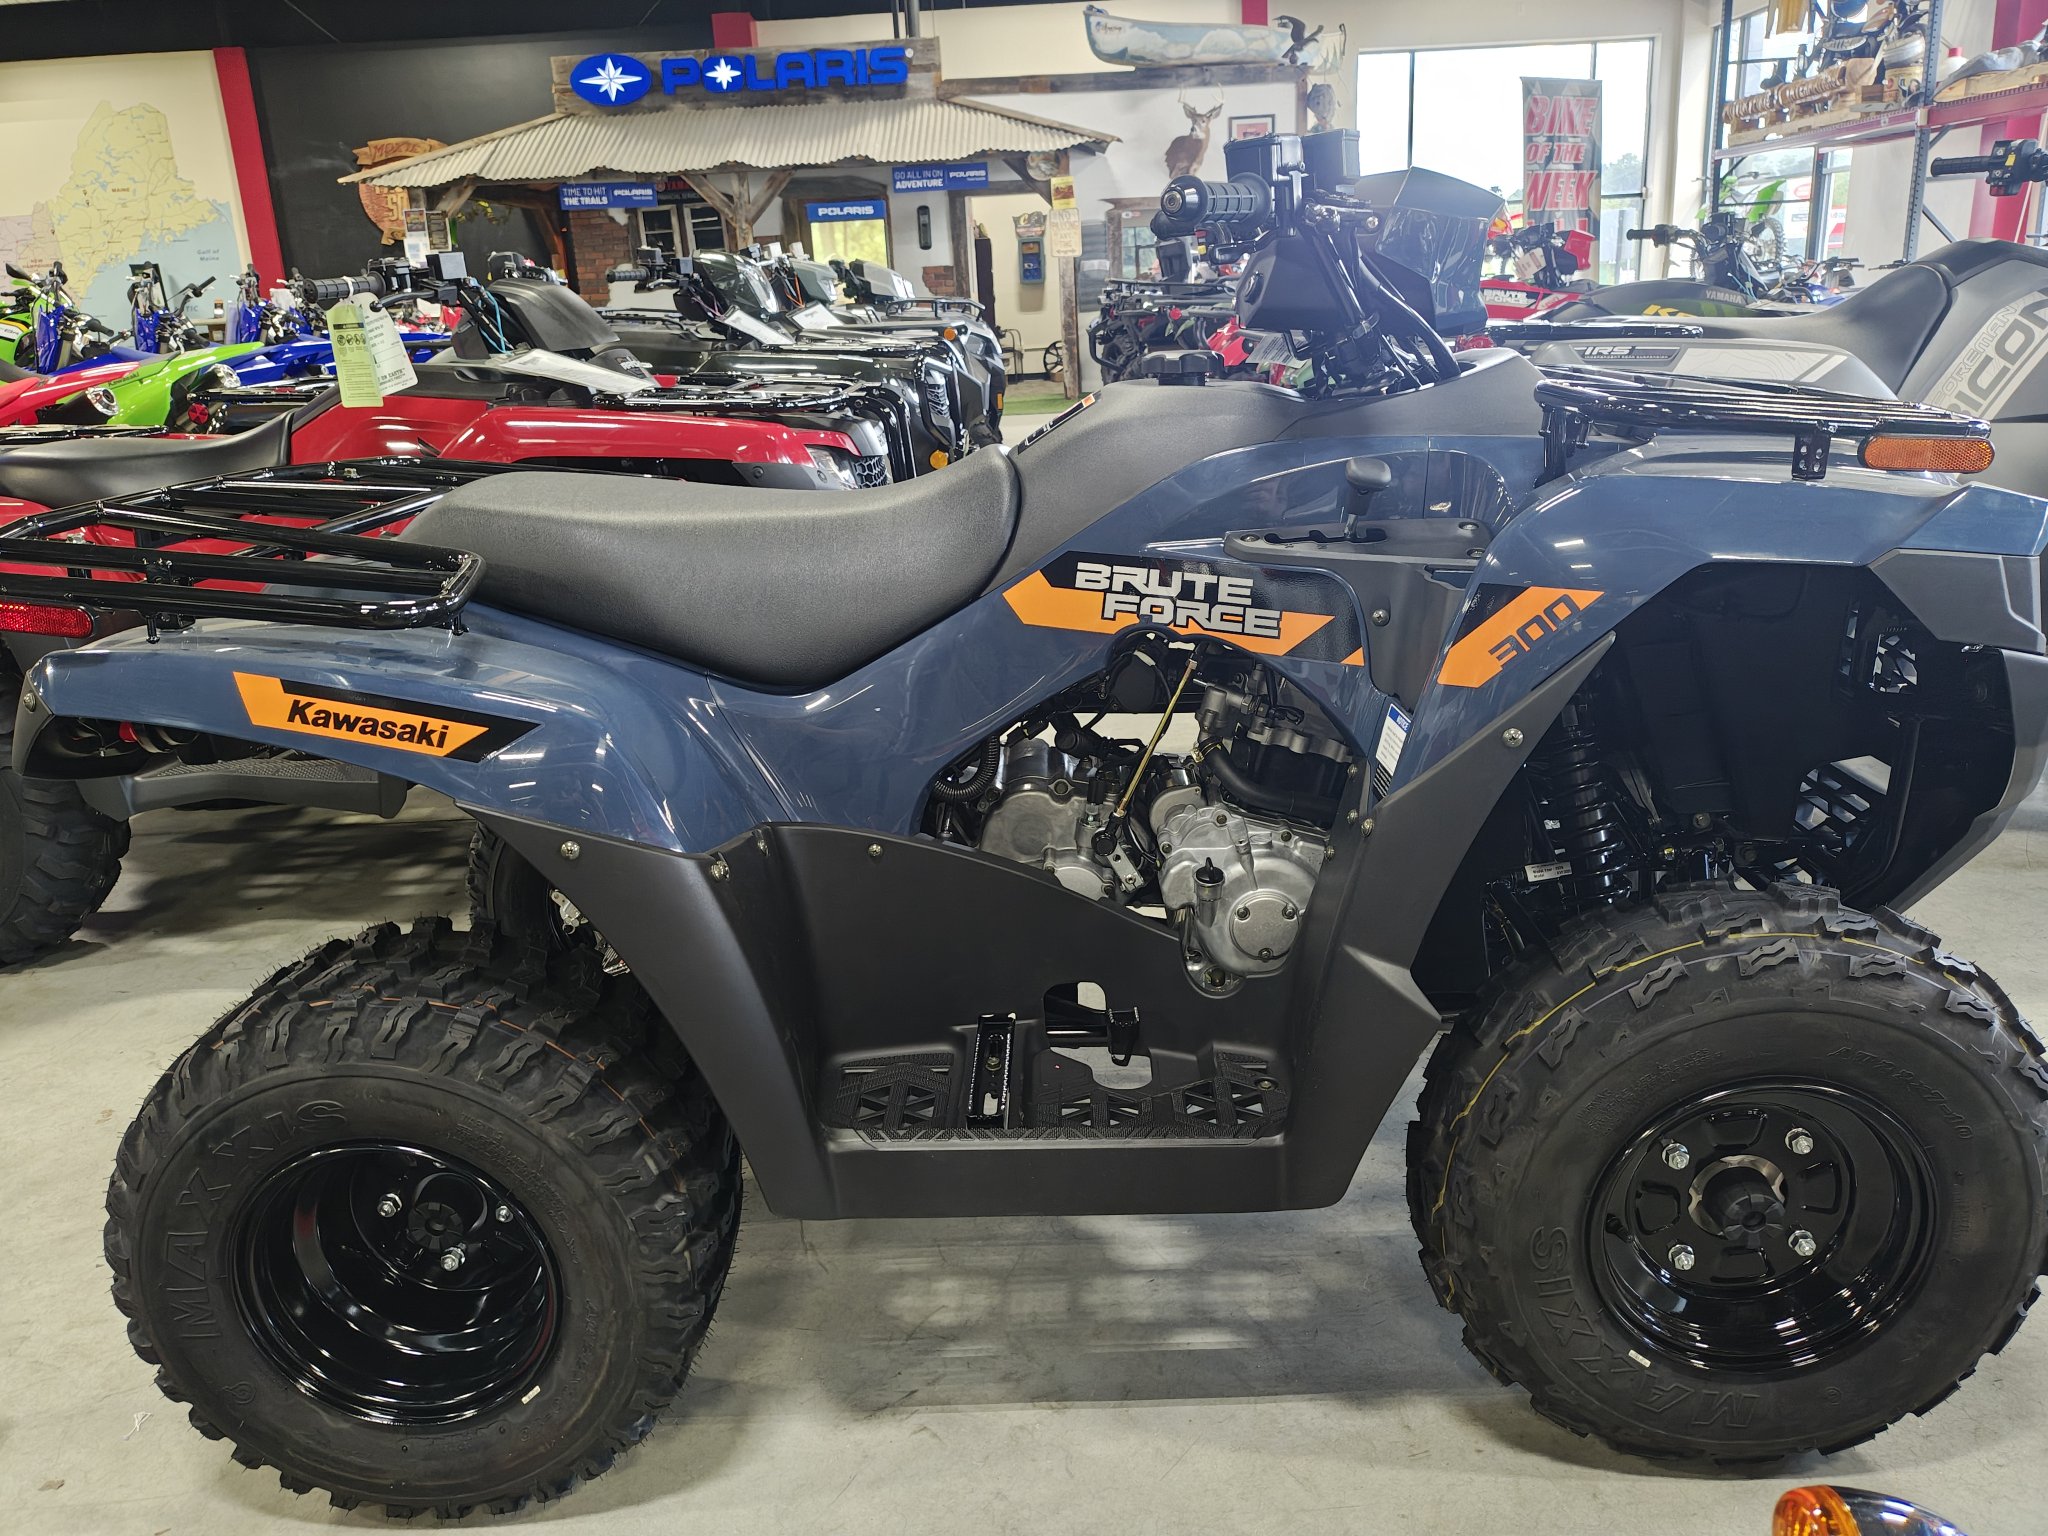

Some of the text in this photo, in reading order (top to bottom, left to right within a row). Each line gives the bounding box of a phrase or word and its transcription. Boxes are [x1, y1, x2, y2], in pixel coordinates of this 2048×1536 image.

[661, 47, 909, 95] POLARIS
[1525, 96, 1598, 137] BIKE
[1526, 142, 1586, 164] OF THE
[894, 171, 905, 179] GO
[907, 171, 921, 179] ALL
[932, 169, 943, 177] ON
[895, 178, 944, 189] ADVENTURE
[949, 170, 986, 178] POLARIS
[562, 187, 581, 196] TIME
[583, 187, 592, 195] TO
[563, 196, 608, 206] THE TRAILS
[613, 188, 653, 196] POLARIS
[1526, 170, 1597, 211] WEEK
[817, 205, 875, 216] POLARIS
[1705, 289, 1744, 303] YAMAHA
[1584, 346, 1632, 355] IRS
[1931, 303, 2018, 403] FOREMAN
[1075, 561, 1254, 606] BRUTE
[1103, 592, 1281, 637] FORCE
[1488, 593, 1581, 661] 300
[287, 699, 449, 749] Kawasaki
[166, 1100, 348, 1337] MAXXIS
[1530, 1226, 1760, 1429] MAXXIS
